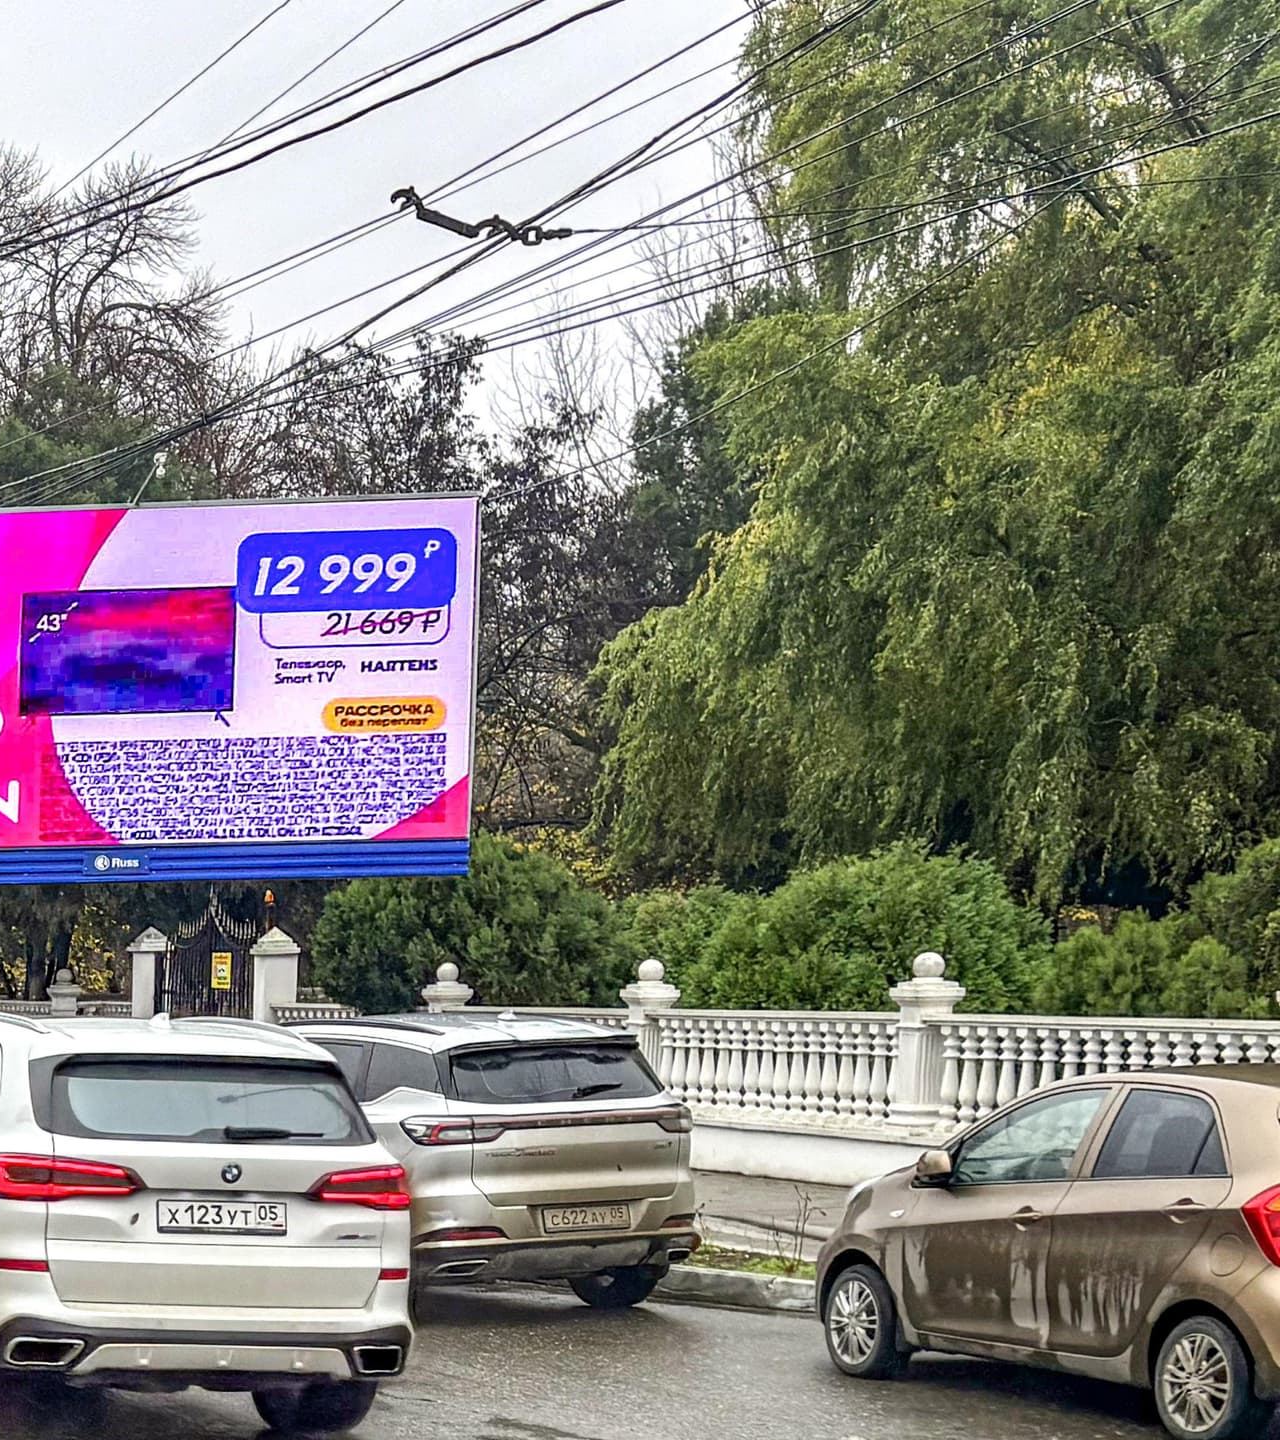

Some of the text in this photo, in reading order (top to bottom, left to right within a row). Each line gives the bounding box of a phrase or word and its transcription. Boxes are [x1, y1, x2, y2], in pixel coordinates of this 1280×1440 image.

[254, 556, 306, 597] 12
[319, 553, 417, 594] 999
[274, 671, 336, 685] Smart TV
[334, 703, 435, 717] РАССРОЧКА
[111, 857, 140, 868] Russ
[257, 1205, 279, 1222] 05
